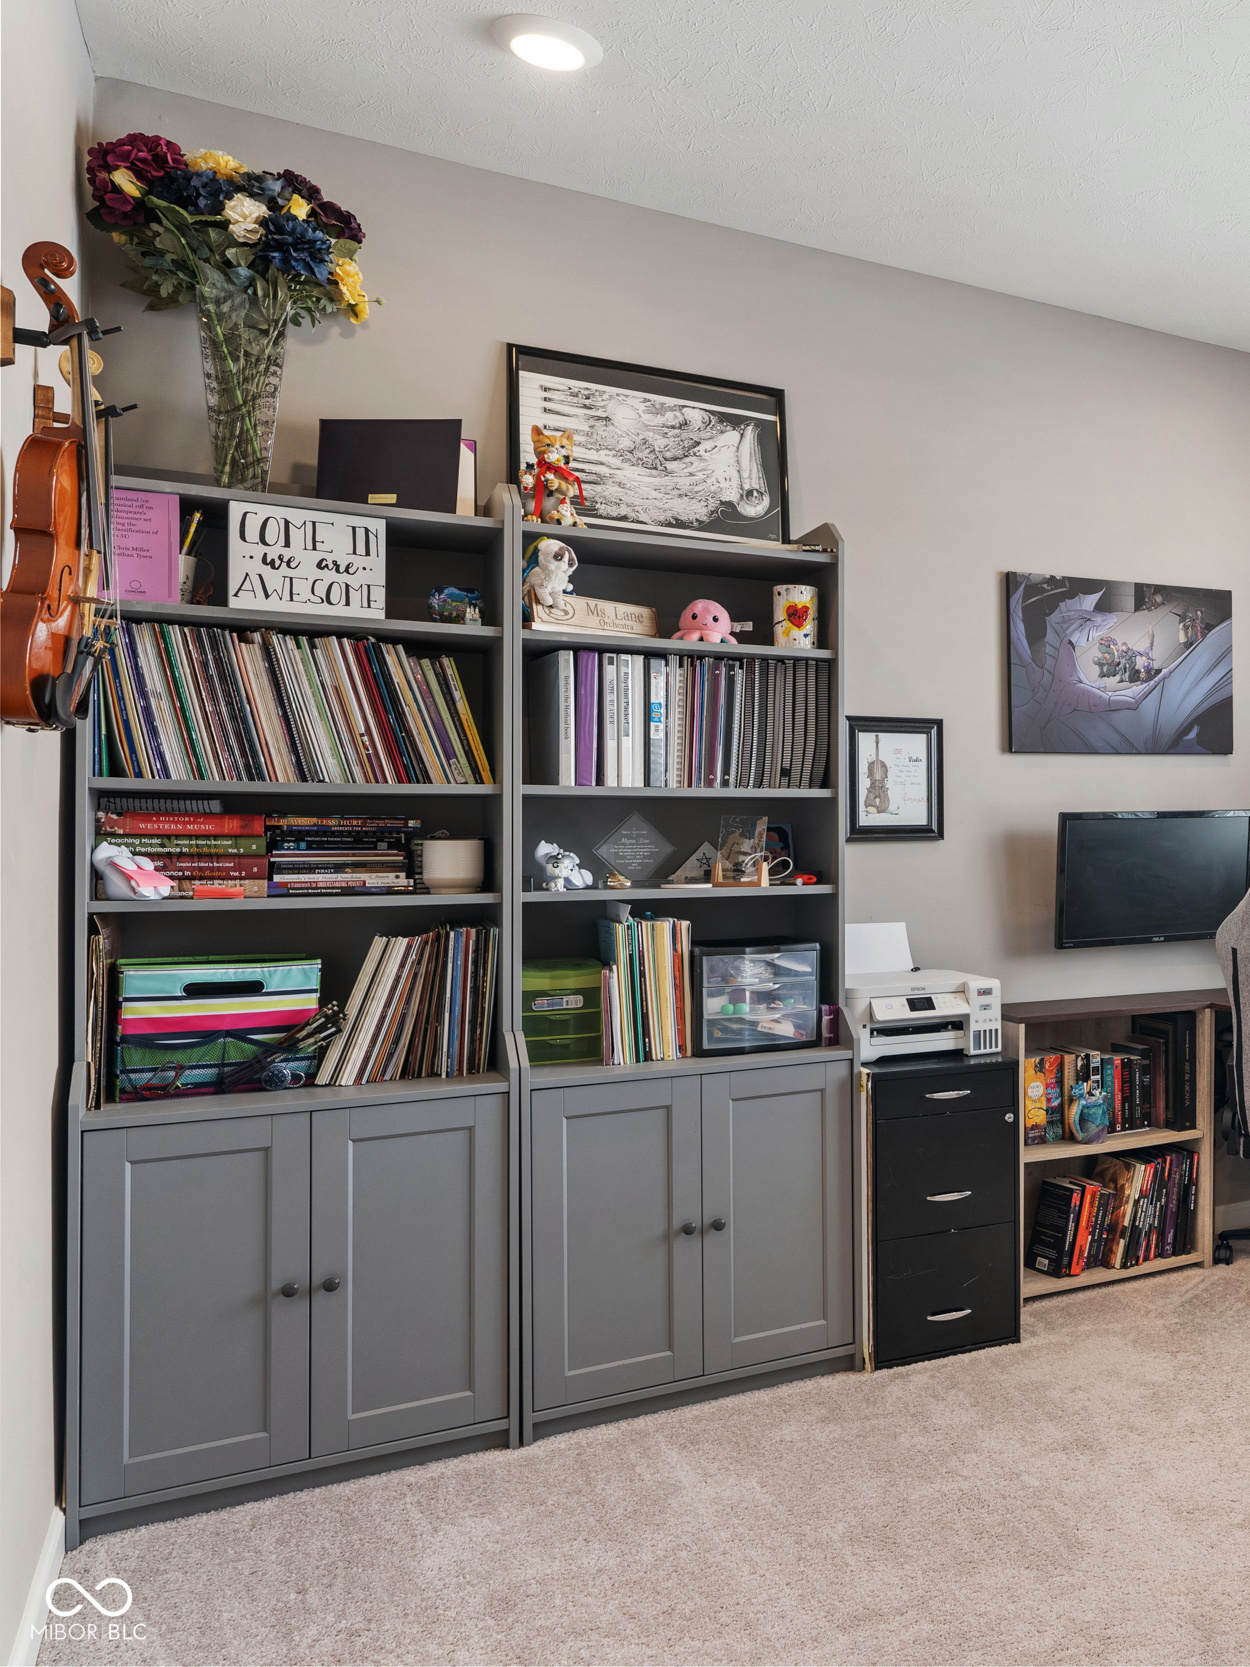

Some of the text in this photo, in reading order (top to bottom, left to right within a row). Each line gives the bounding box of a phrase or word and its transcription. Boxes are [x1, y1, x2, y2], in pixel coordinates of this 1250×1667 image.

[238, 511, 380, 558] COME IN
[261, 552, 360, 576] we are
[232, 572, 384, 610] AWESOME
[586, 602, 644, 624] Ms. Lane
[598, 618, 634, 630] Orchestra
